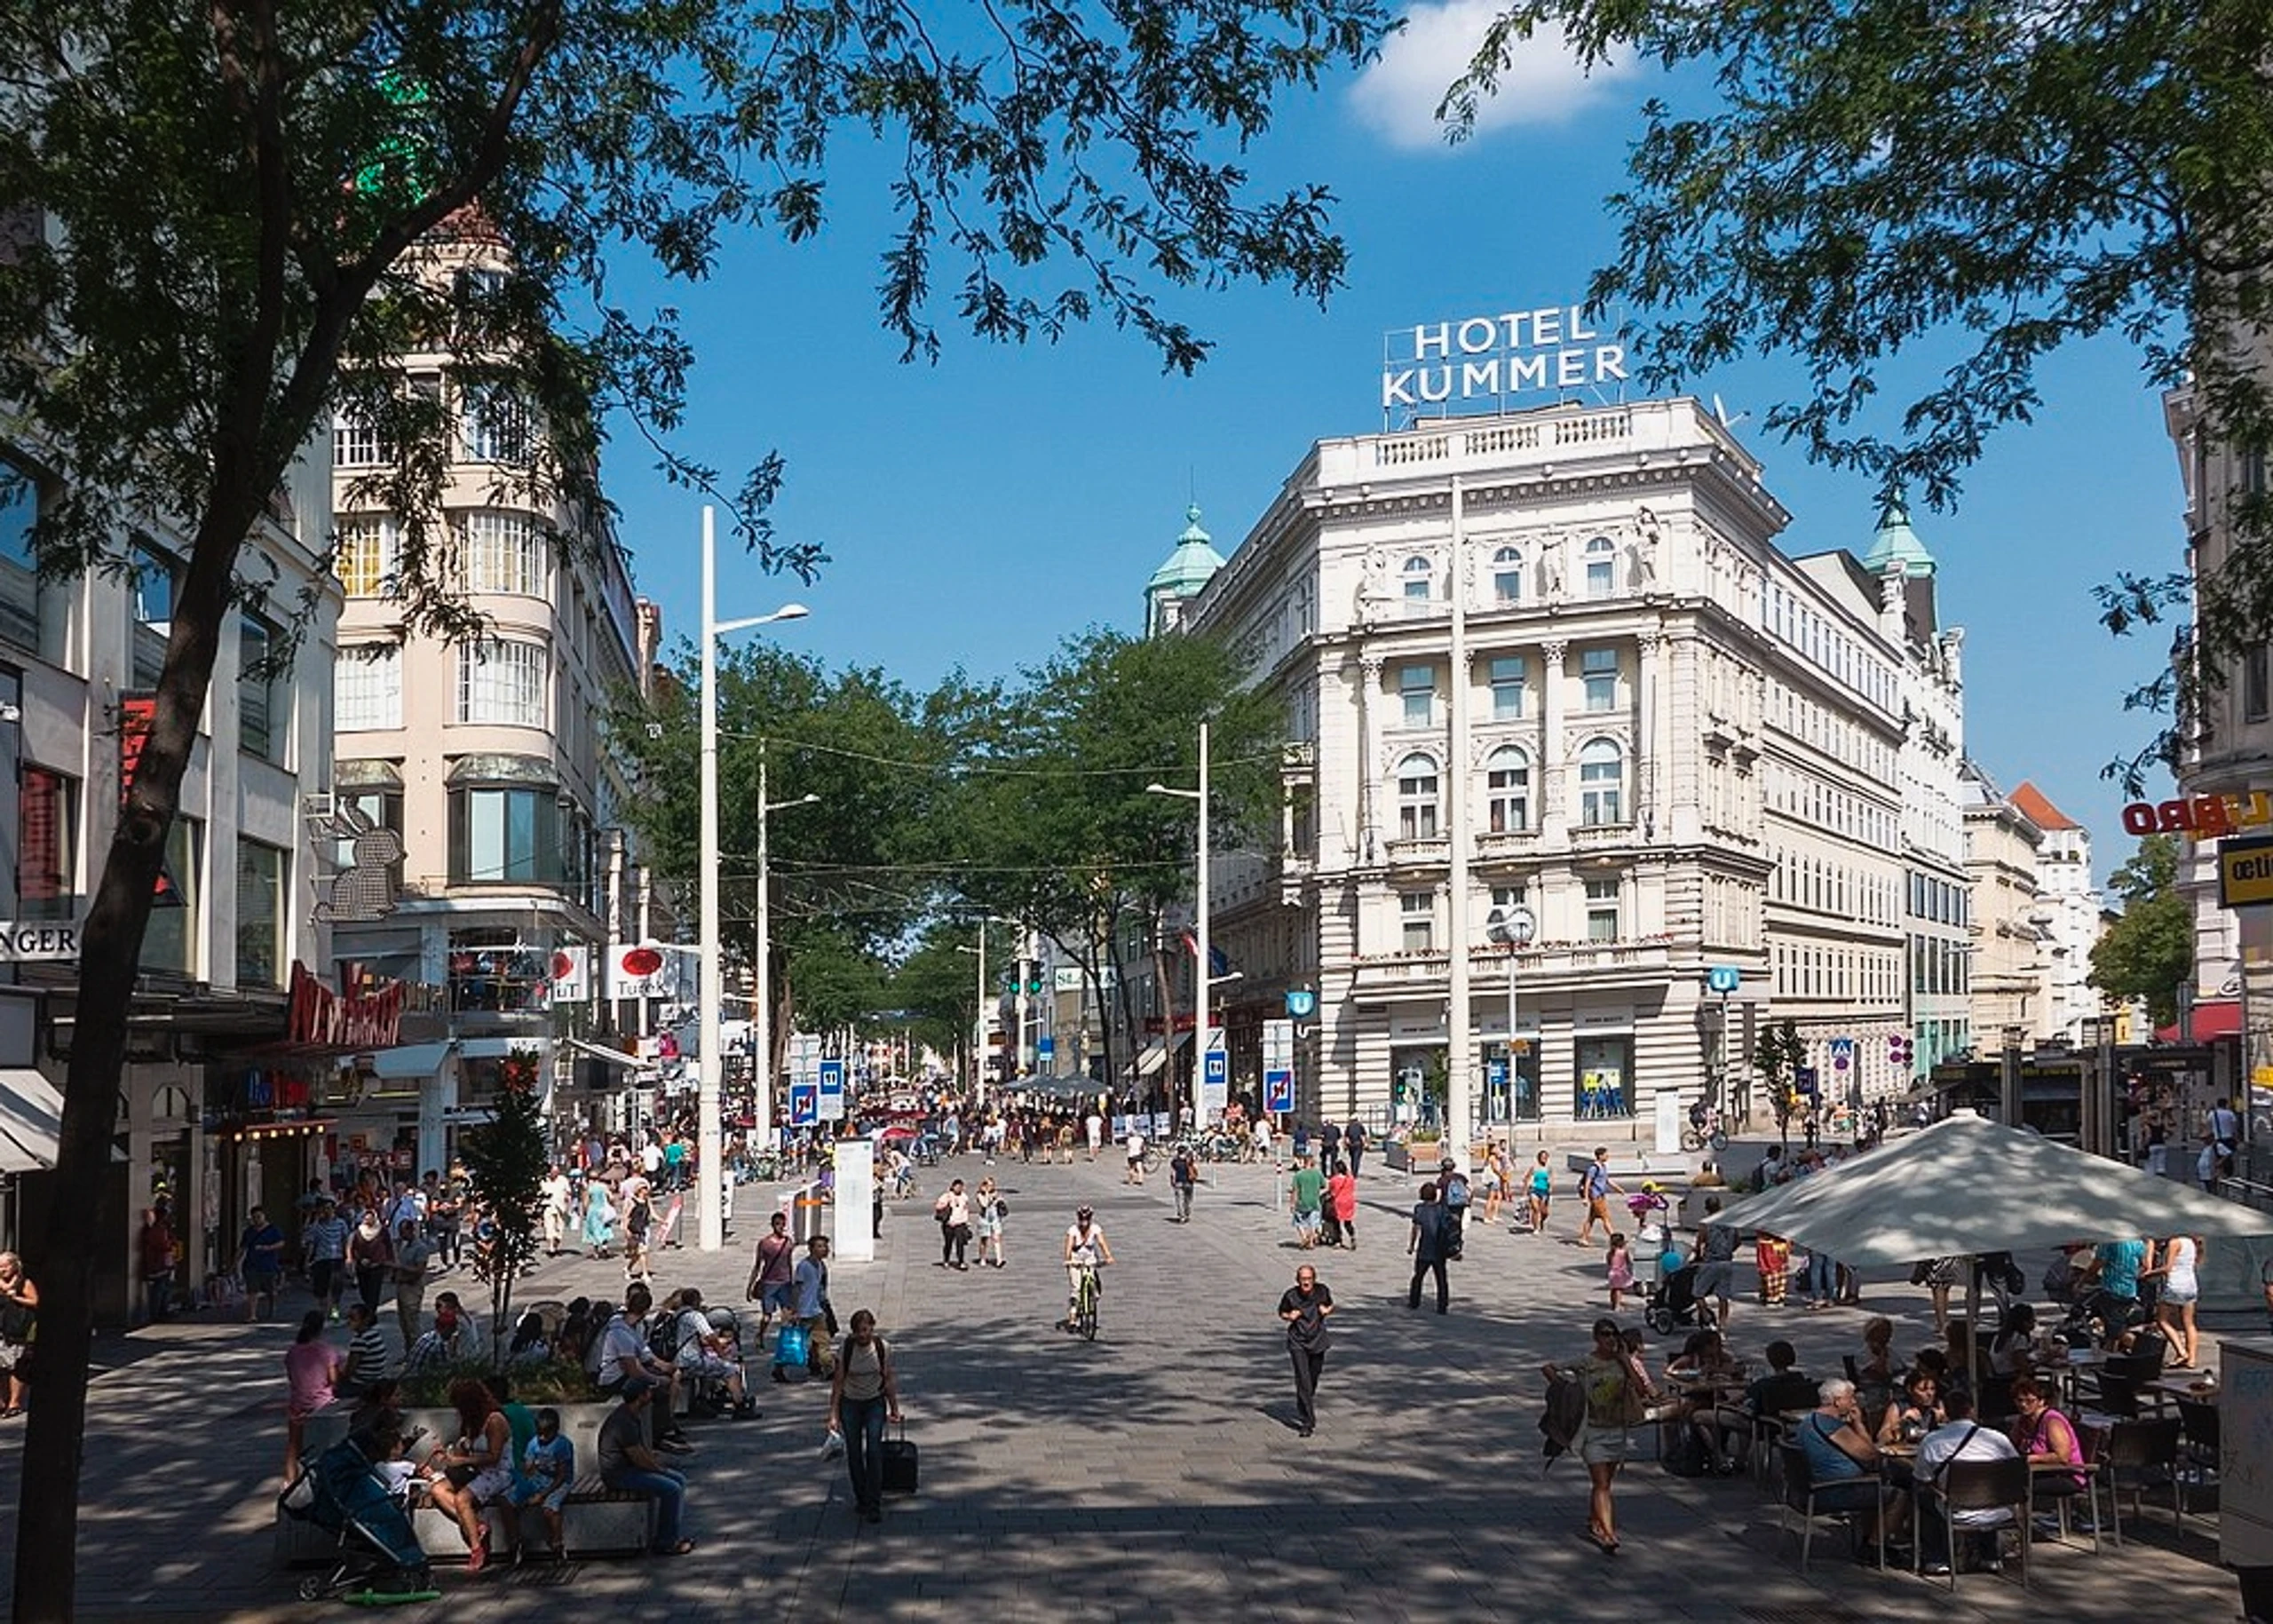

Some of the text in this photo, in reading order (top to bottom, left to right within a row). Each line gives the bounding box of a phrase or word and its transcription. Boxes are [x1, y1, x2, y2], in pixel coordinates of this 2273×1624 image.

[1415, 305, 1596, 360] HOTEL
[1382, 345, 1629, 407] KUMMER
[1713, 971, 1730, 988] U
[1294, 995, 1310, 1014] U
